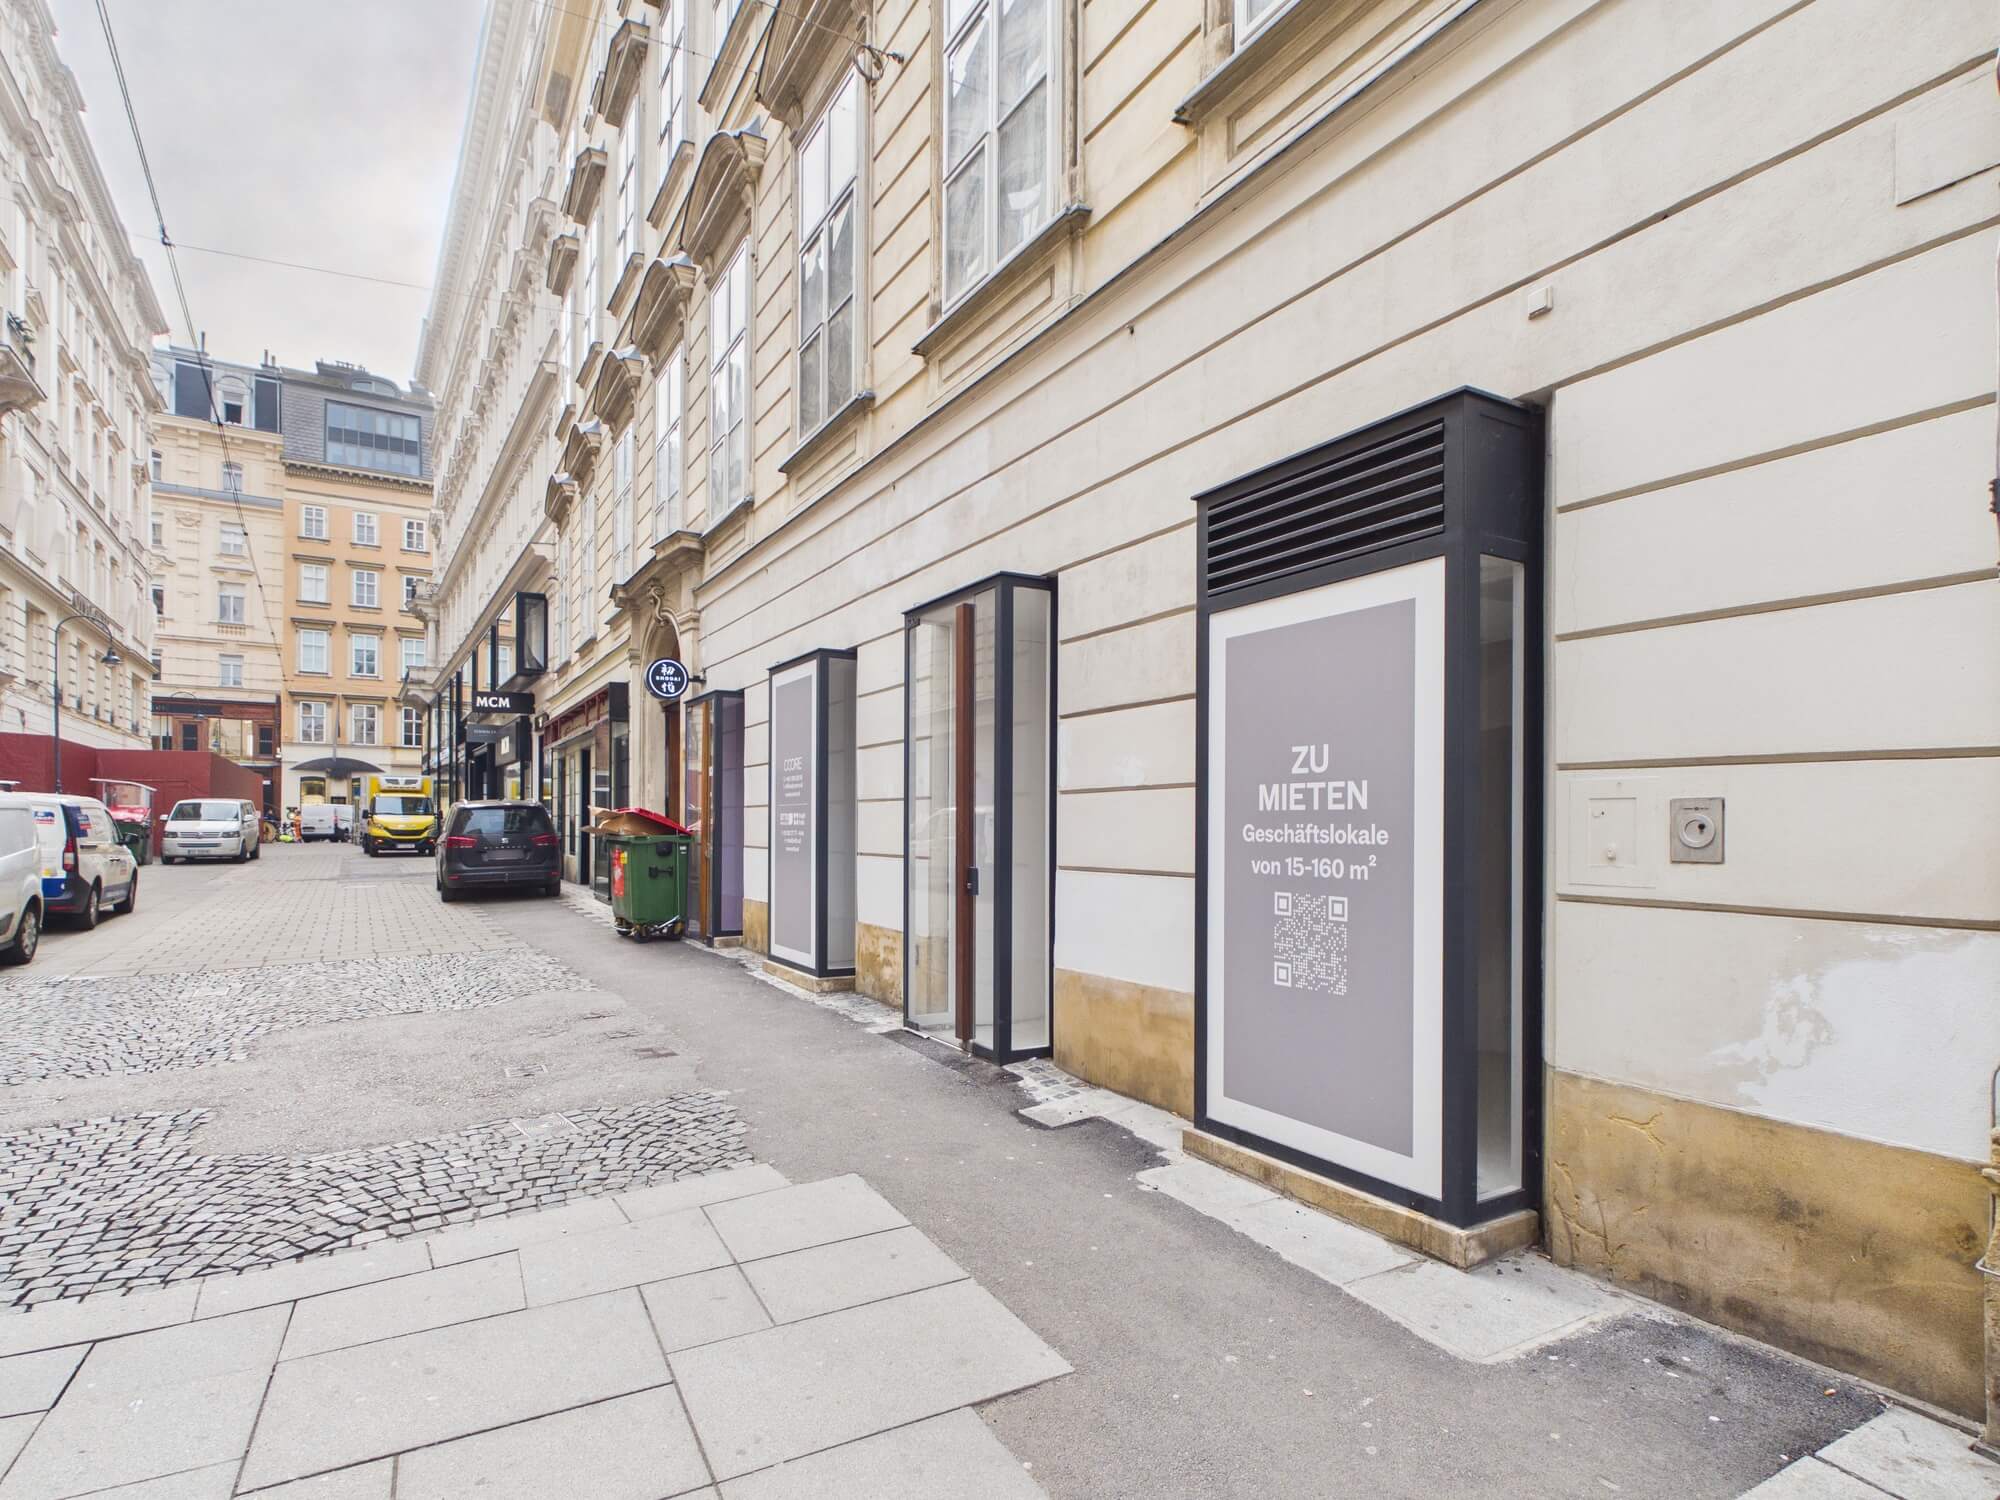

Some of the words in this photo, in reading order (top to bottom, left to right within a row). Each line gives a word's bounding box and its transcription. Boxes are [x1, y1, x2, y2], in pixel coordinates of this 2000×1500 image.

[476, 696, 511, 709] MCM
[1291, 743, 1329, 775] ZU
[1258, 779, 1368, 812] MIETEN
[1242, 823, 1389, 846] Geschäftslokale
[1251, 859, 1281, 876] von
[1285, 856, 1345, 879] 15-160
[1349, 854, 1377, 881] m²
